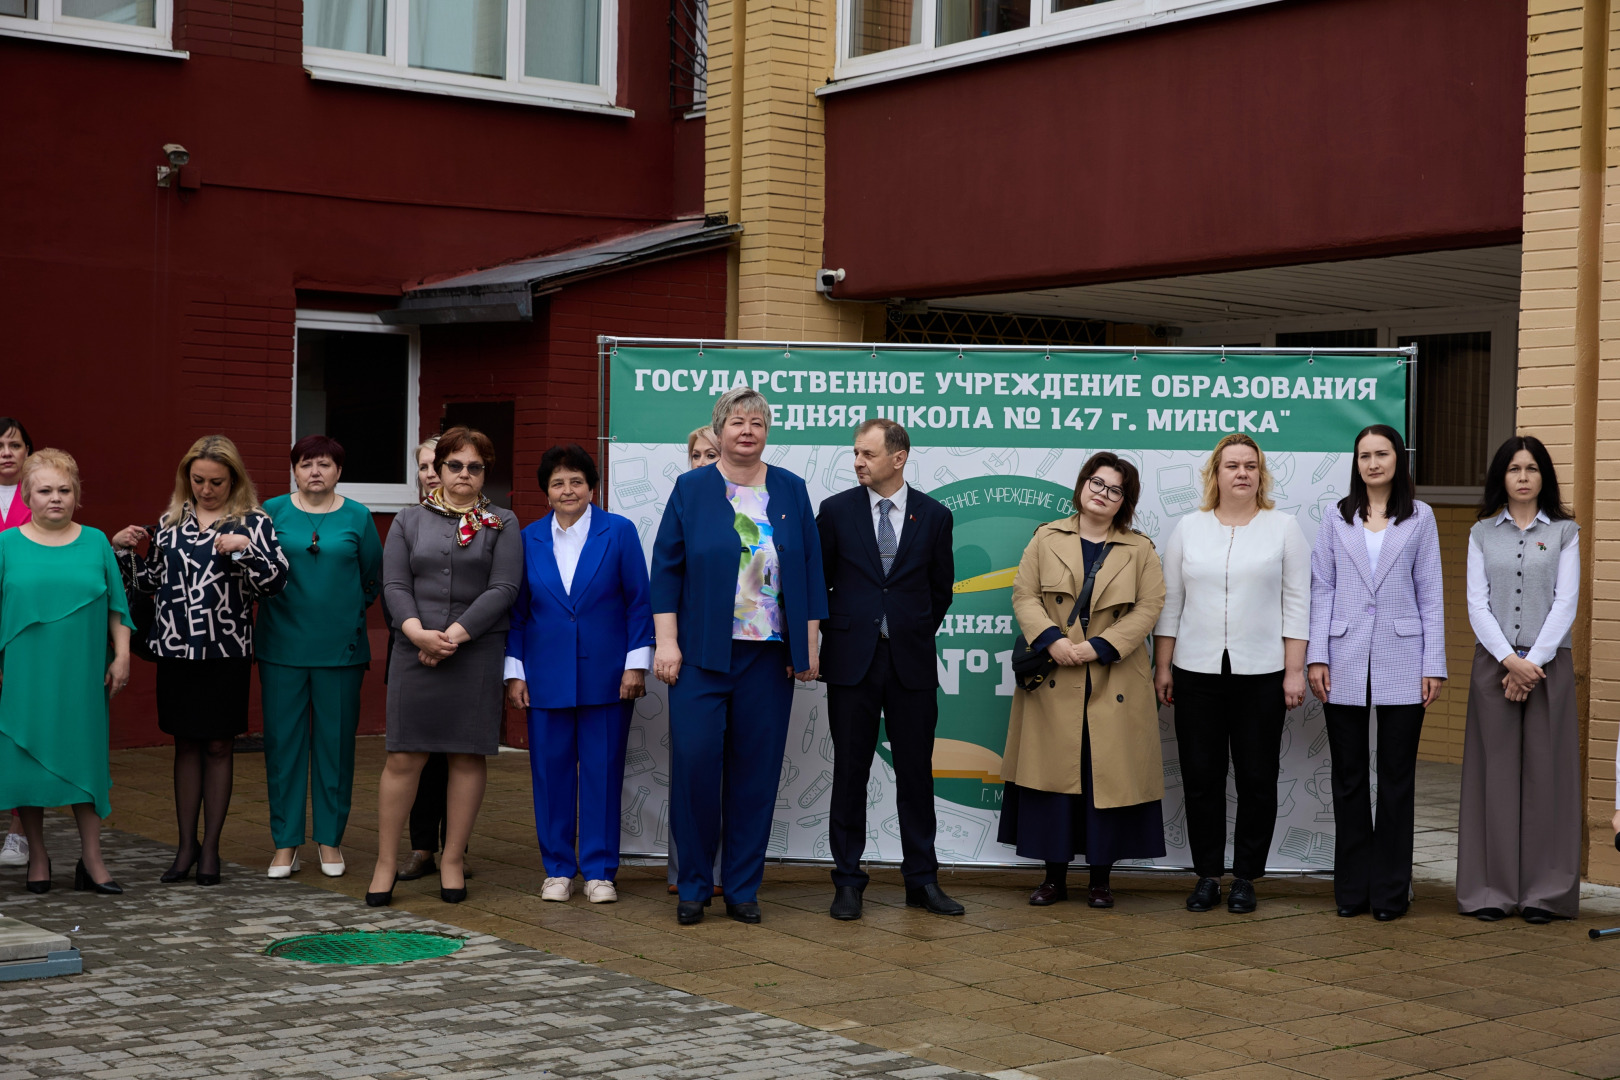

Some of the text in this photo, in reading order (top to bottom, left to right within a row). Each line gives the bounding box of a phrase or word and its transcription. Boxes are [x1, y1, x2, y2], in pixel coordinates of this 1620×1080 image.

[634, 368, 1378, 401] ГОСУДАРСТВЕННОЕ УЧРЕЖДЕНИЕ ОБРАЗОВАНИЯ
[769, 404, 868, 431] ЕДНЯЯ
[1003, 406, 1041, 430] №
[1051, 407, 1103, 431] 147
[1111, 412, 1137, 431] г.
[1147, 408, 1291, 434] МИНСКА"
[983, 487, 1055, 509] УЧРЕЖДЕНИЕ
[934, 614, 1014, 637] ДНЯЯ
